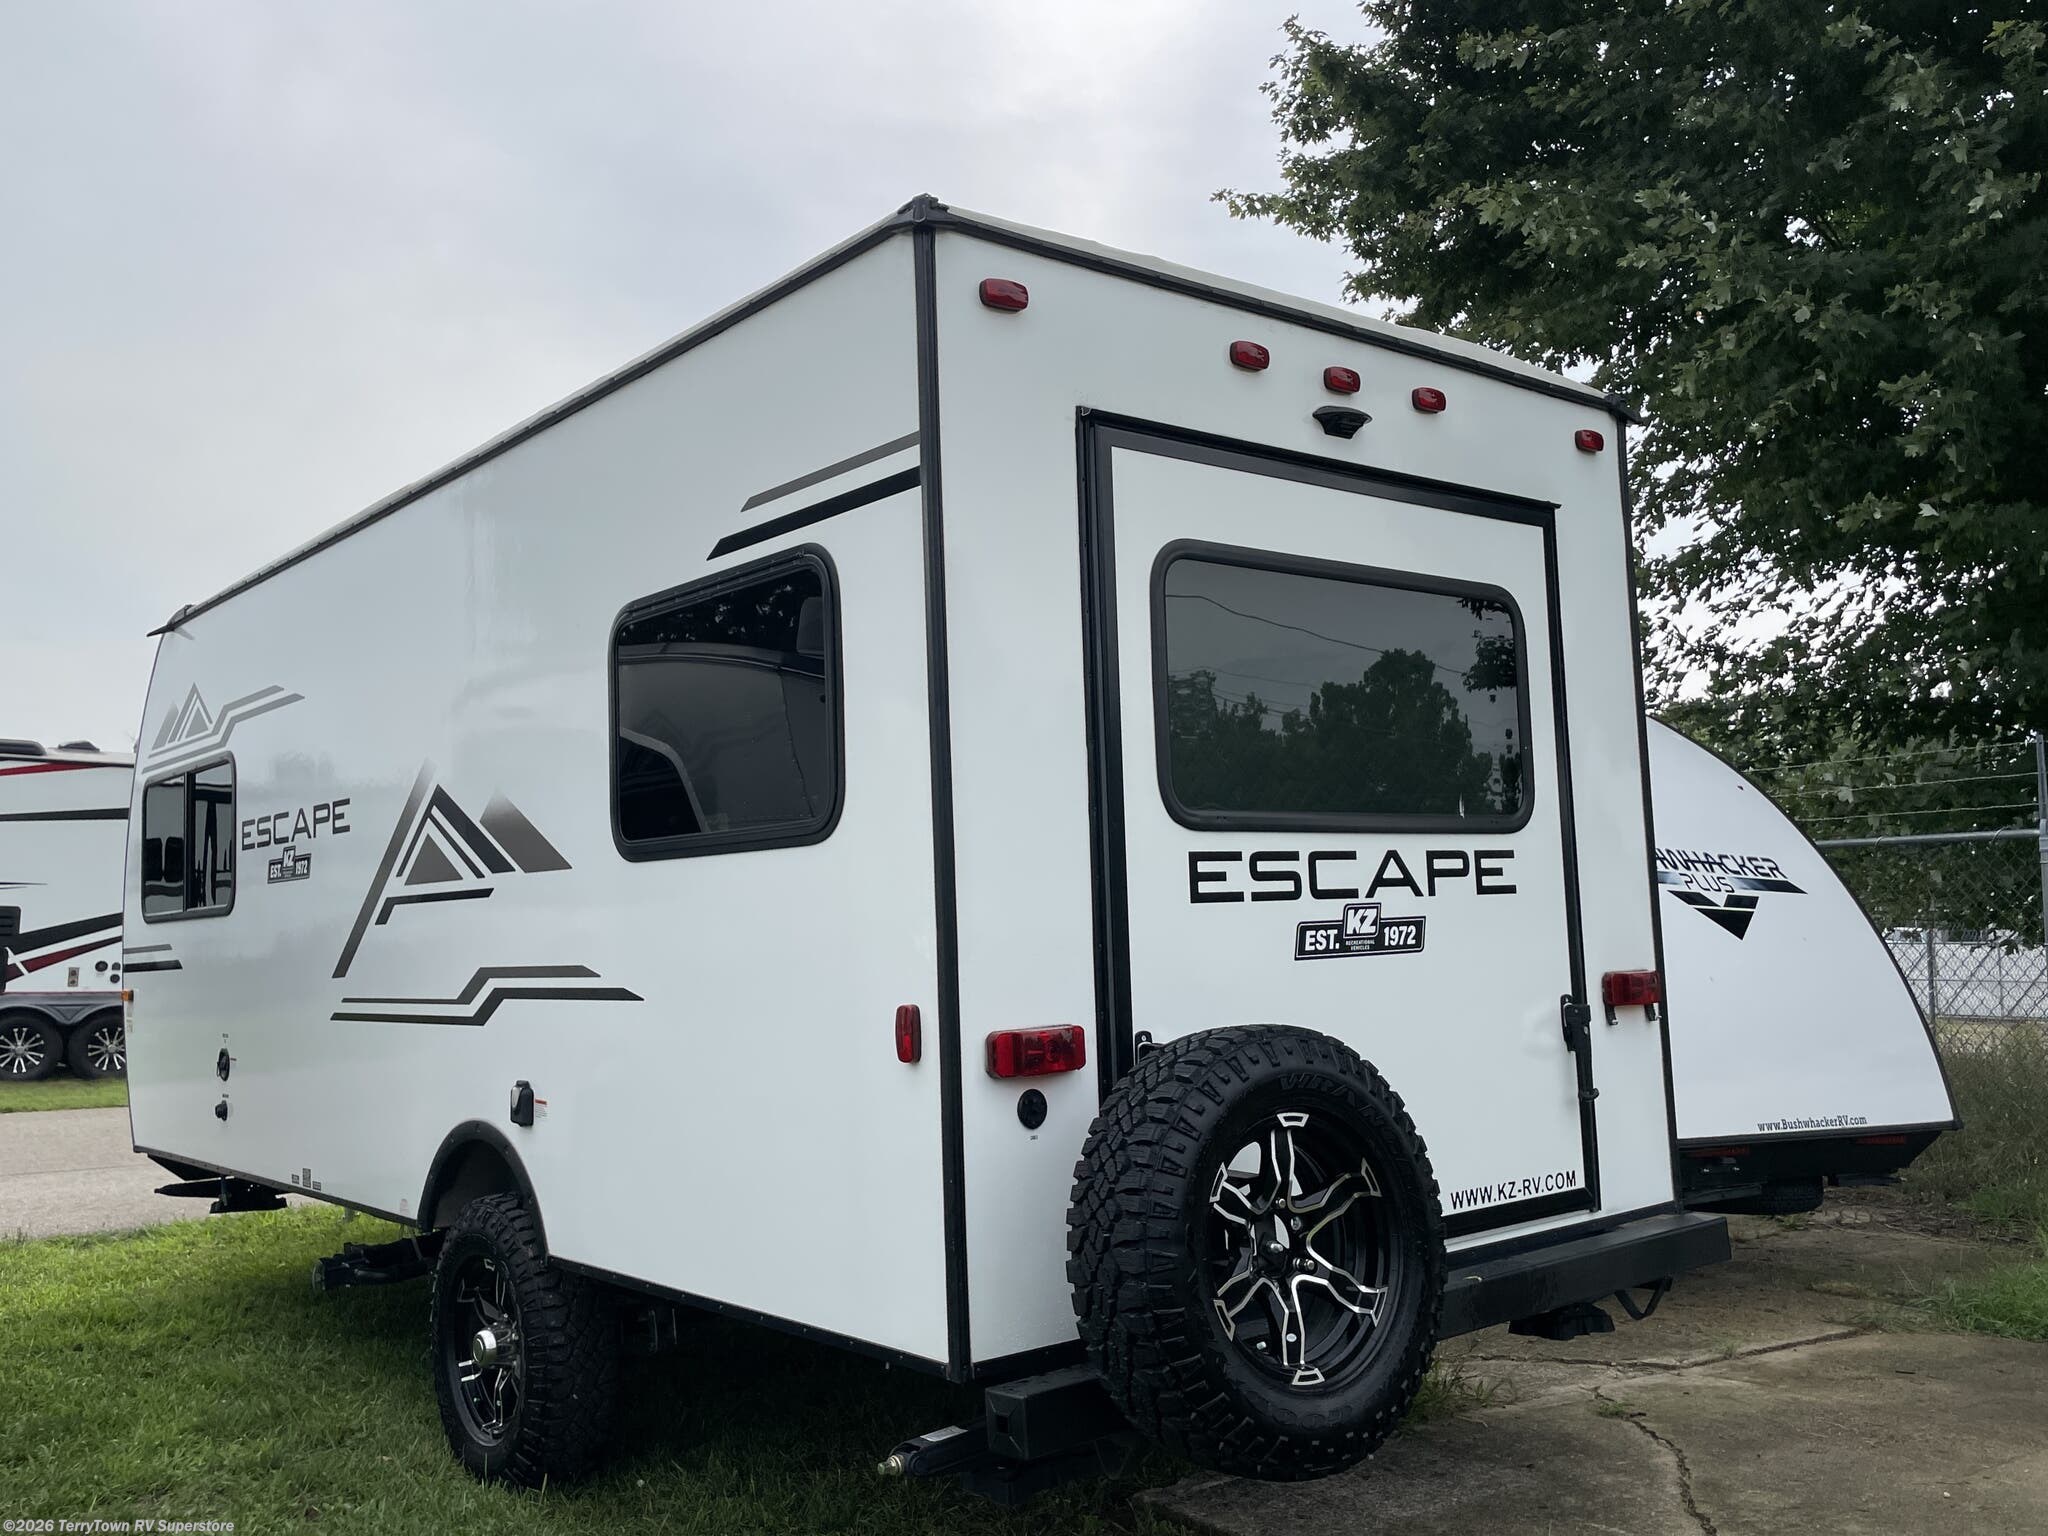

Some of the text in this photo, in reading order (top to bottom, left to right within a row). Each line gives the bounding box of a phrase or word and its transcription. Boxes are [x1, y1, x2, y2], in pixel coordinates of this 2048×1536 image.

[241, 798, 351, 851] ESCAPE
[270, 864, 282, 879] EST.
[295, 859, 308, 875] 1972
[1188, 849, 1518, 904] ESCAPE
[1679, 872, 1736, 893] PLUS
[1346, 908, 1378, 935] KZ
[1304, 925, 1416, 951] EST. 1972
[1757, 1115, 1868, 1132] www.BushwhackerRV.com
[1450, 1170, 1577, 1210] WWW.KZ-RV.COM
